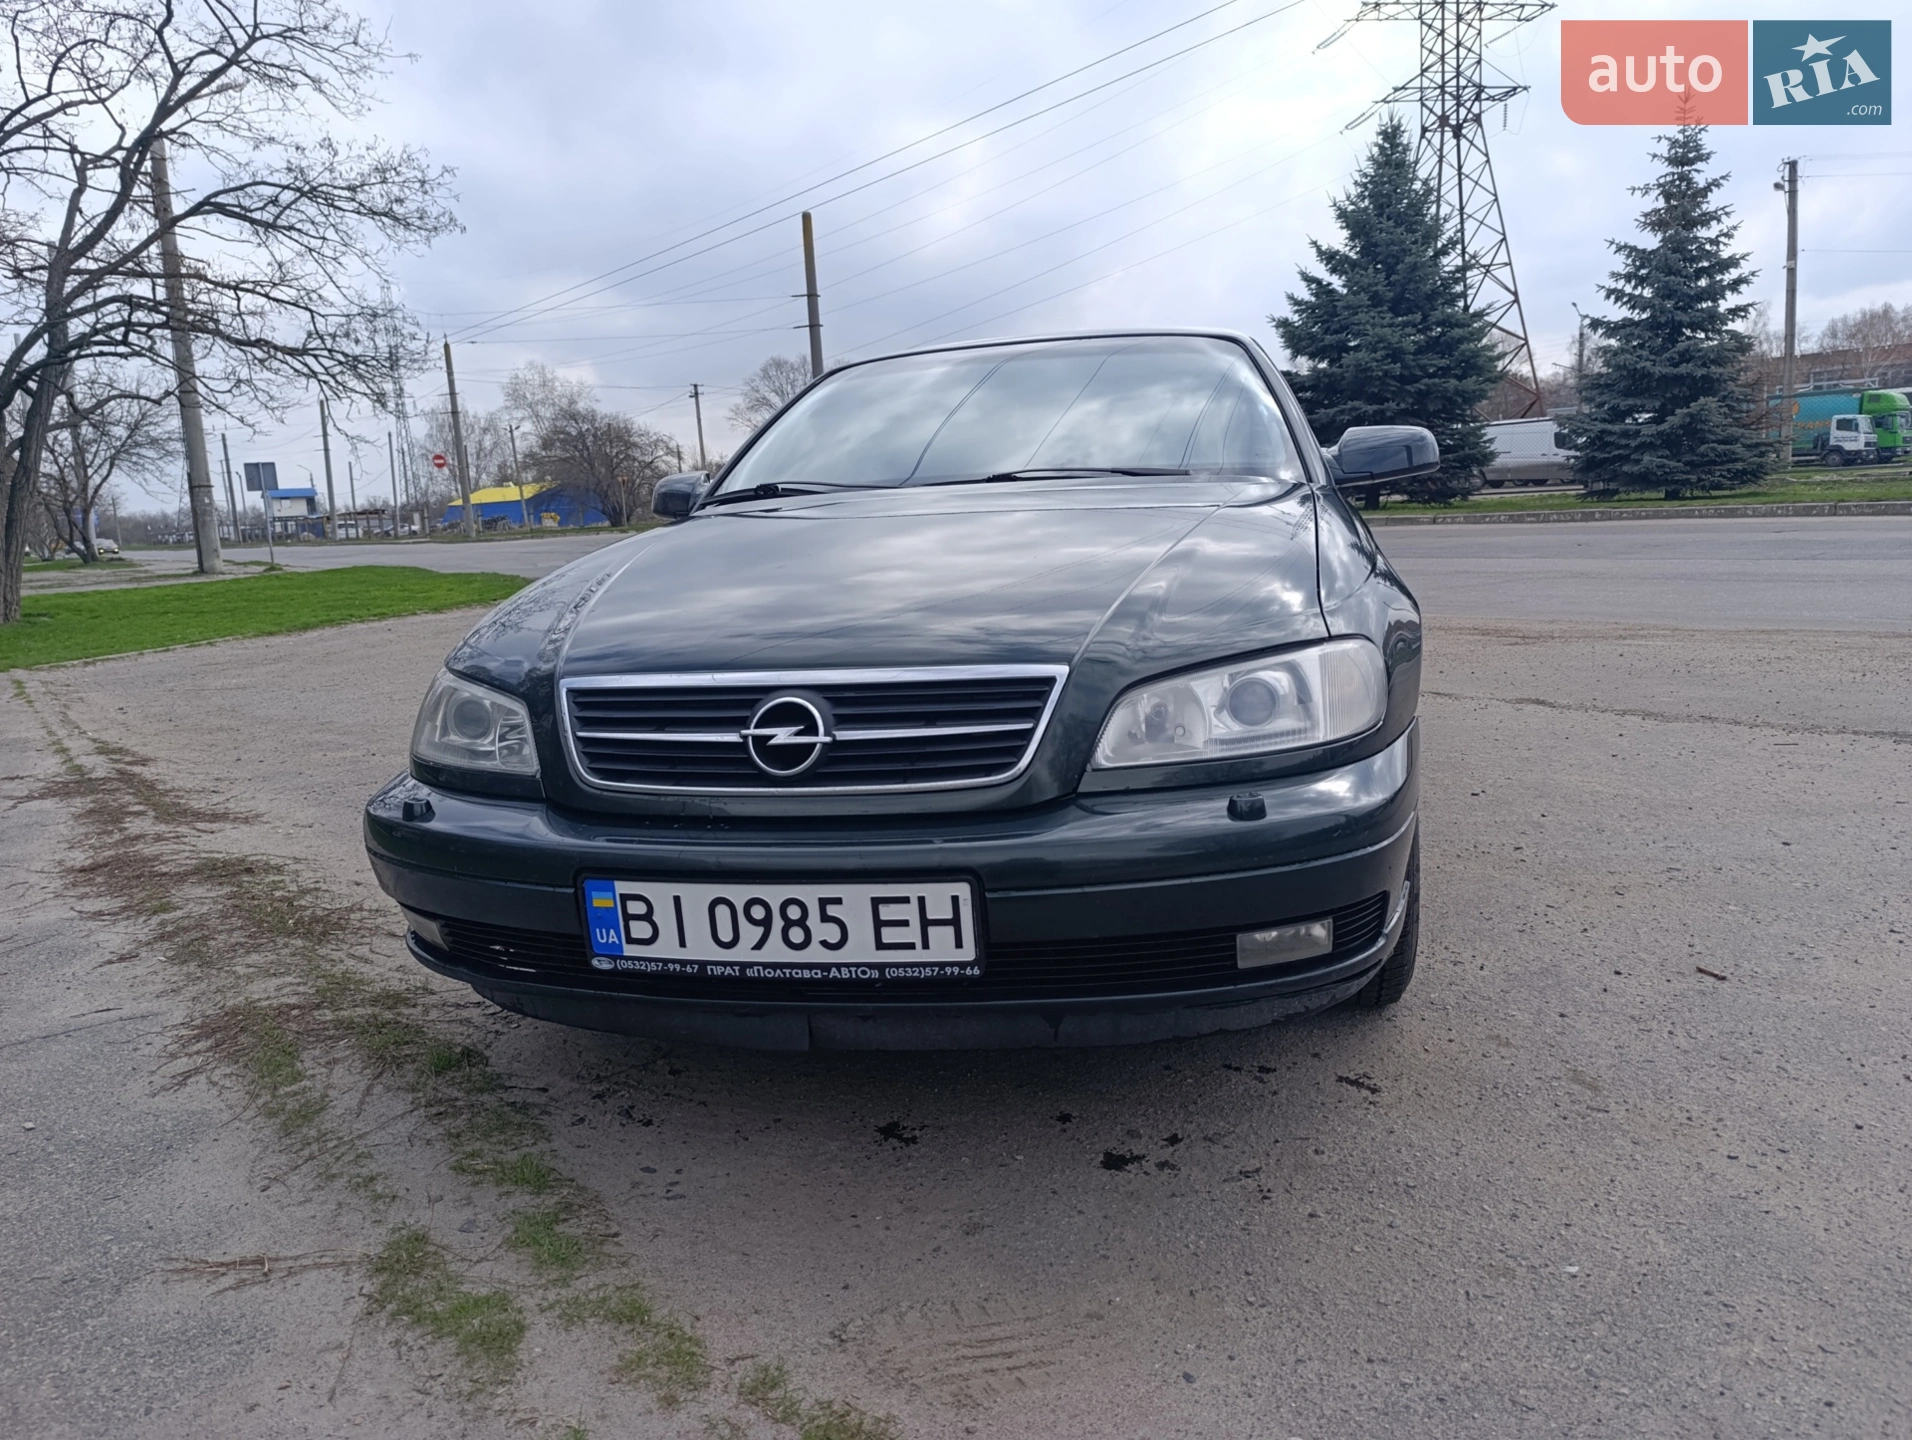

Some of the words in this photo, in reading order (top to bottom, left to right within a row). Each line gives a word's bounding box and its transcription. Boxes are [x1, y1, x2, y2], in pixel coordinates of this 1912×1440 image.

[619, 893, 687, 949] BI
[708, 896, 849, 951] 0985
[870, 894, 964, 951] EH
[596, 928, 620, 944] UA
[616, 959, 699, 974] (0532)57-99-67
[706, 965, 741, 977] ПРАТ
[746, 965, 880, 979] «Полтава-АВТО»
[885, 966, 981, 979] (0532)57-99-66
